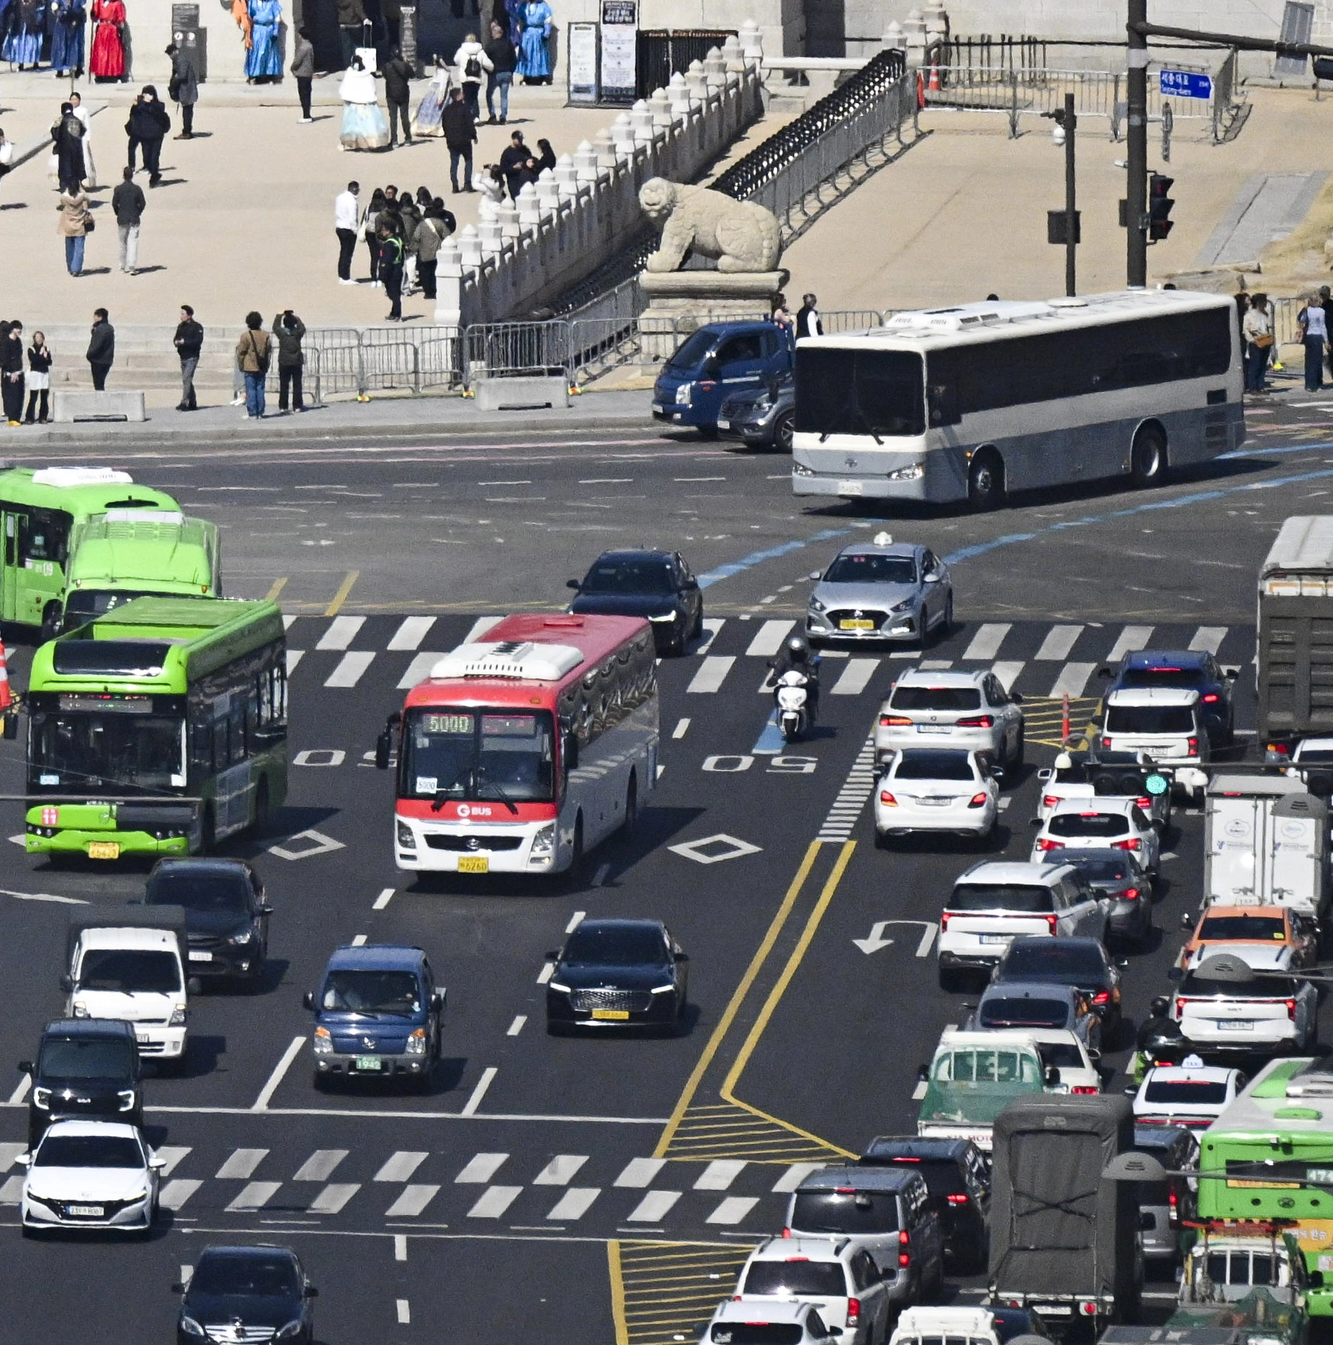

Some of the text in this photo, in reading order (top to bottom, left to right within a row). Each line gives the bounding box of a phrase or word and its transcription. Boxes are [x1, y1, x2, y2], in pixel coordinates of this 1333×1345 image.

[429, 716, 469, 733] 5000
[471, 807, 492, 816] BUS
[358, 1061, 381, 1069] 1942
